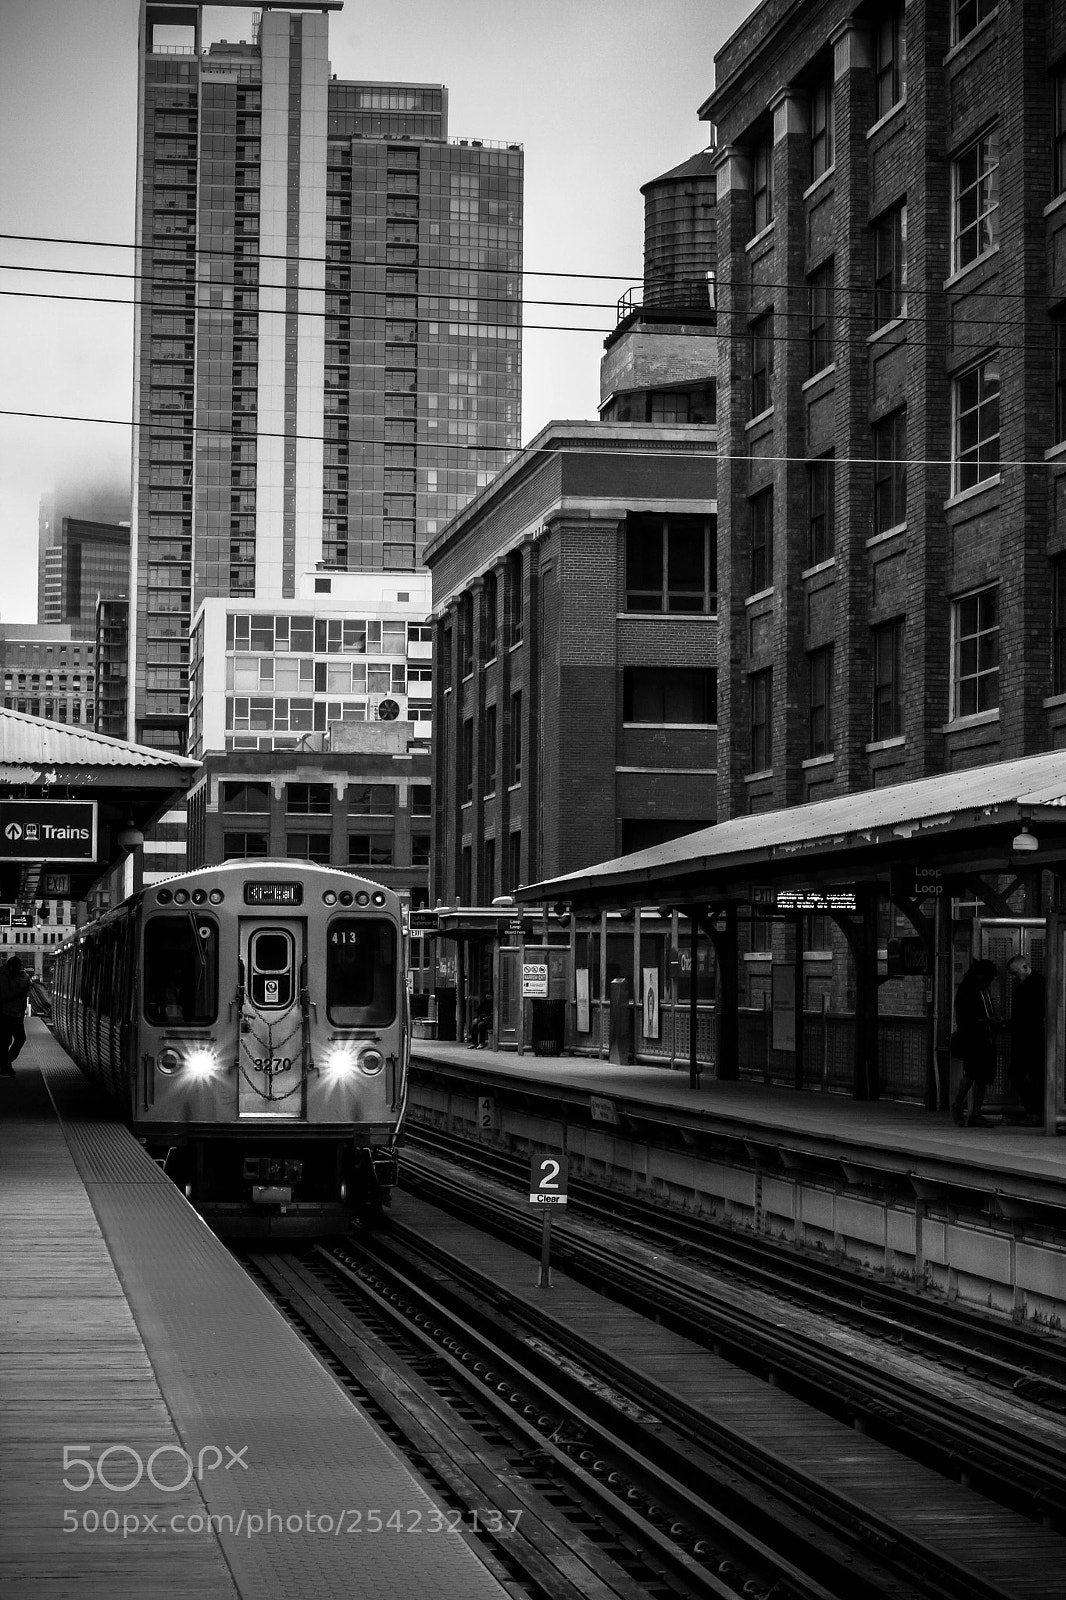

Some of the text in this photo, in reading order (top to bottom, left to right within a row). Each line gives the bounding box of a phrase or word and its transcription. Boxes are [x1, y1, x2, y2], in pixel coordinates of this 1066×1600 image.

[42, 824, 90, 840] Trains
[915, 866, 943, 879] Loop
[47, 877, 67, 892] EXIT
[915, 882, 944, 896] Loop
[753, 888, 774, 902] EXIT
[331, 931, 357, 944] 413
[482, 1099, 490, 1111] 4
[482, 1114, 491, 1127] 2
[538, 1159, 560, 1189] 2
[537, 1194, 560, 1203] Clear
